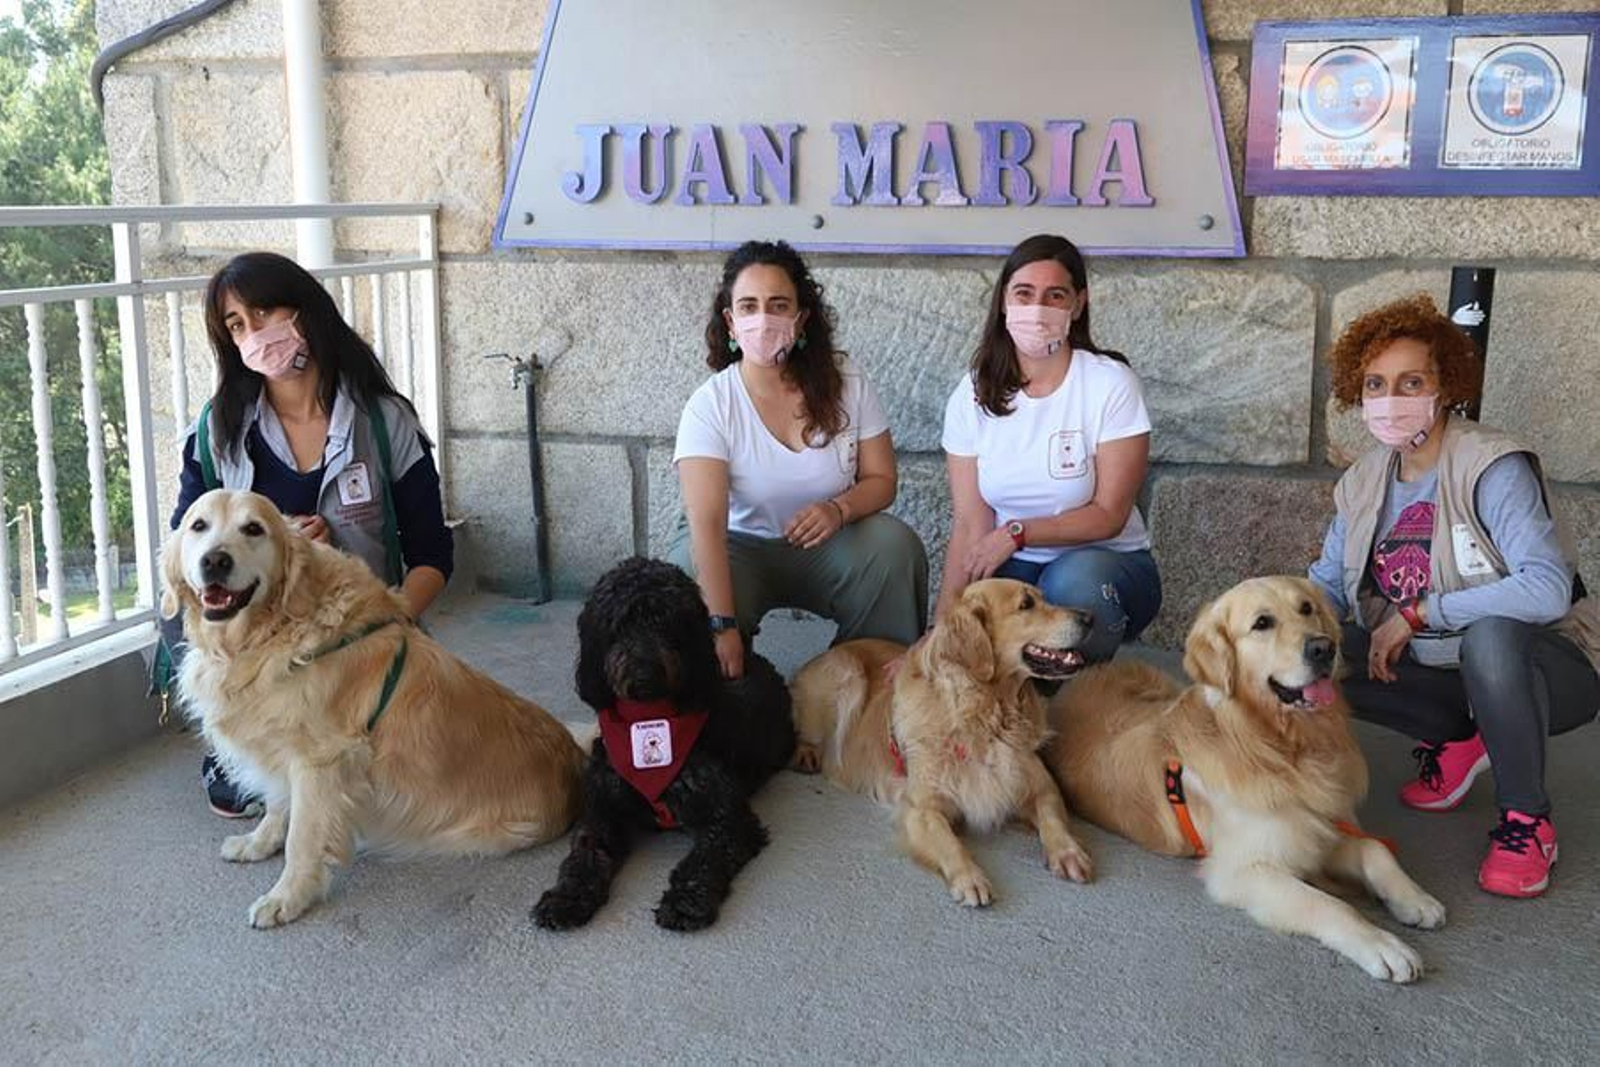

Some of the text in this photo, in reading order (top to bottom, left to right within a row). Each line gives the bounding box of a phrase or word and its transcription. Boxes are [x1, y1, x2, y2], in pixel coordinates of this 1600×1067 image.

[1471, 138, 1551, 148] OBLIGATORIO
[1530, 151, 1574, 162] MANOS
[562, 119, 1156, 207] JUAN MARIA
